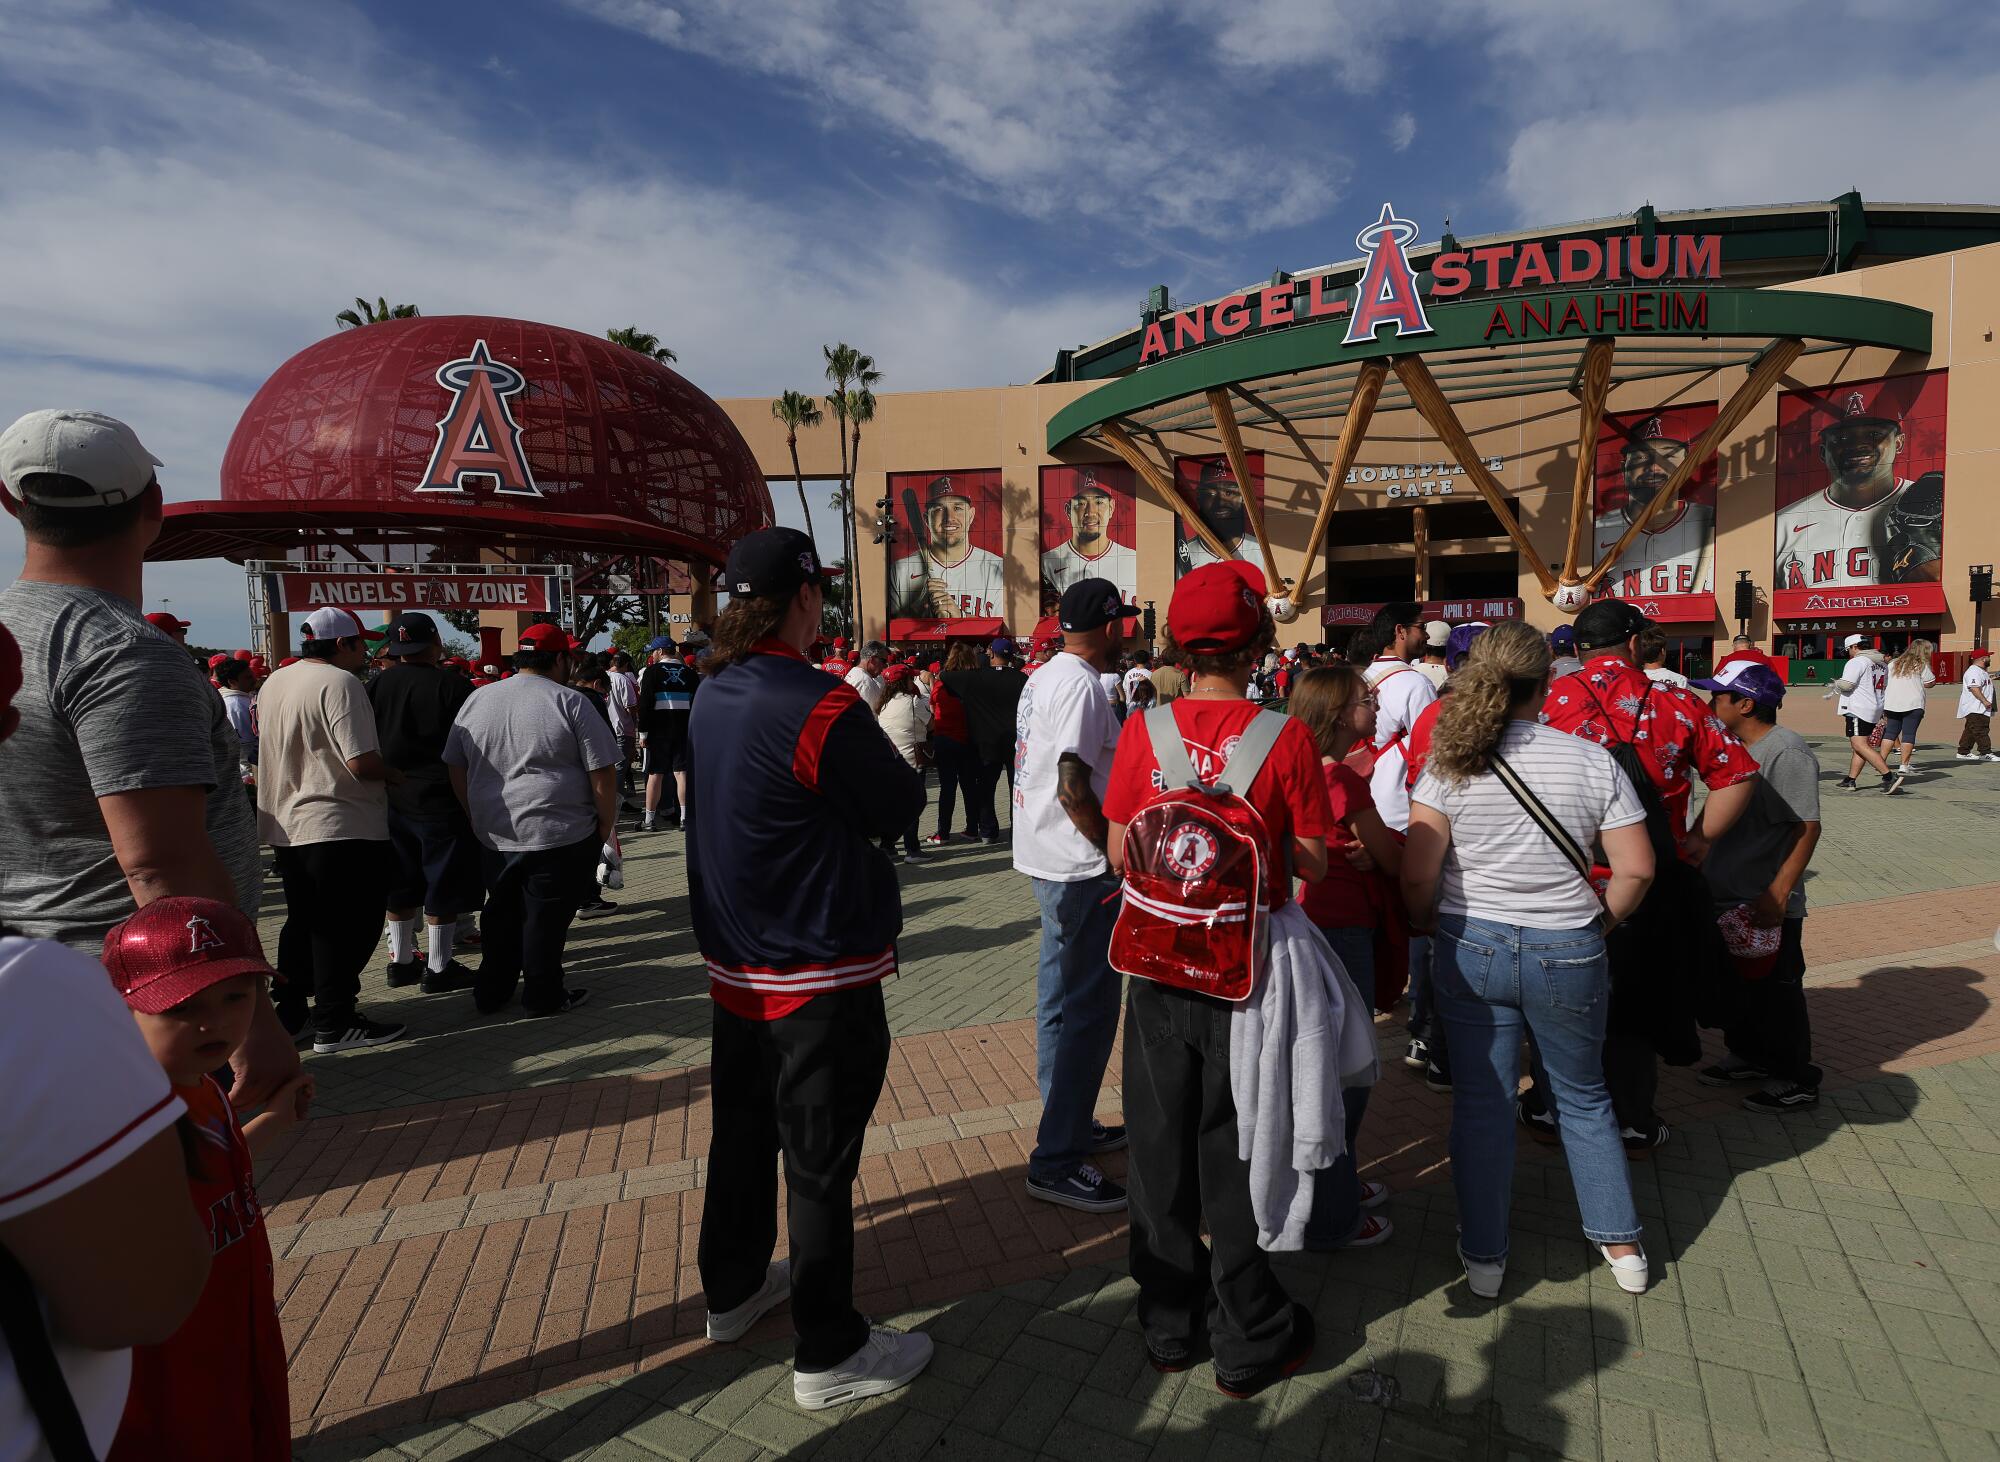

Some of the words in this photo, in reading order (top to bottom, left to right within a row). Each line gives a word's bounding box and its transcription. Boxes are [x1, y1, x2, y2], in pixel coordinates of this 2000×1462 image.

[1431, 234, 1723, 296] STADIUM
[1484, 292, 1709, 340] ANAHEIM
[413, 338, 545, 498] A
[1344, 455, 1504, 484] HOMEPLAE
[1386, 479, 1454, 499] GATE
[308, 581, 407, 605] ANGELS
[413, 576, 461, 606] FAN
[466, 582, 529, 605] ZONE
[1805, 594, 1911, 610] ANGELS
[1442, 604, 1465, 618] APRIL
[1466, 603, 1472, 617] 3
[1483, 602, 1506, 617] APRIL
[1788, 621, 1838, 632] TEAM
[1856, 619, 1921, 631] STORE
[186, 915, 225, 953] A
